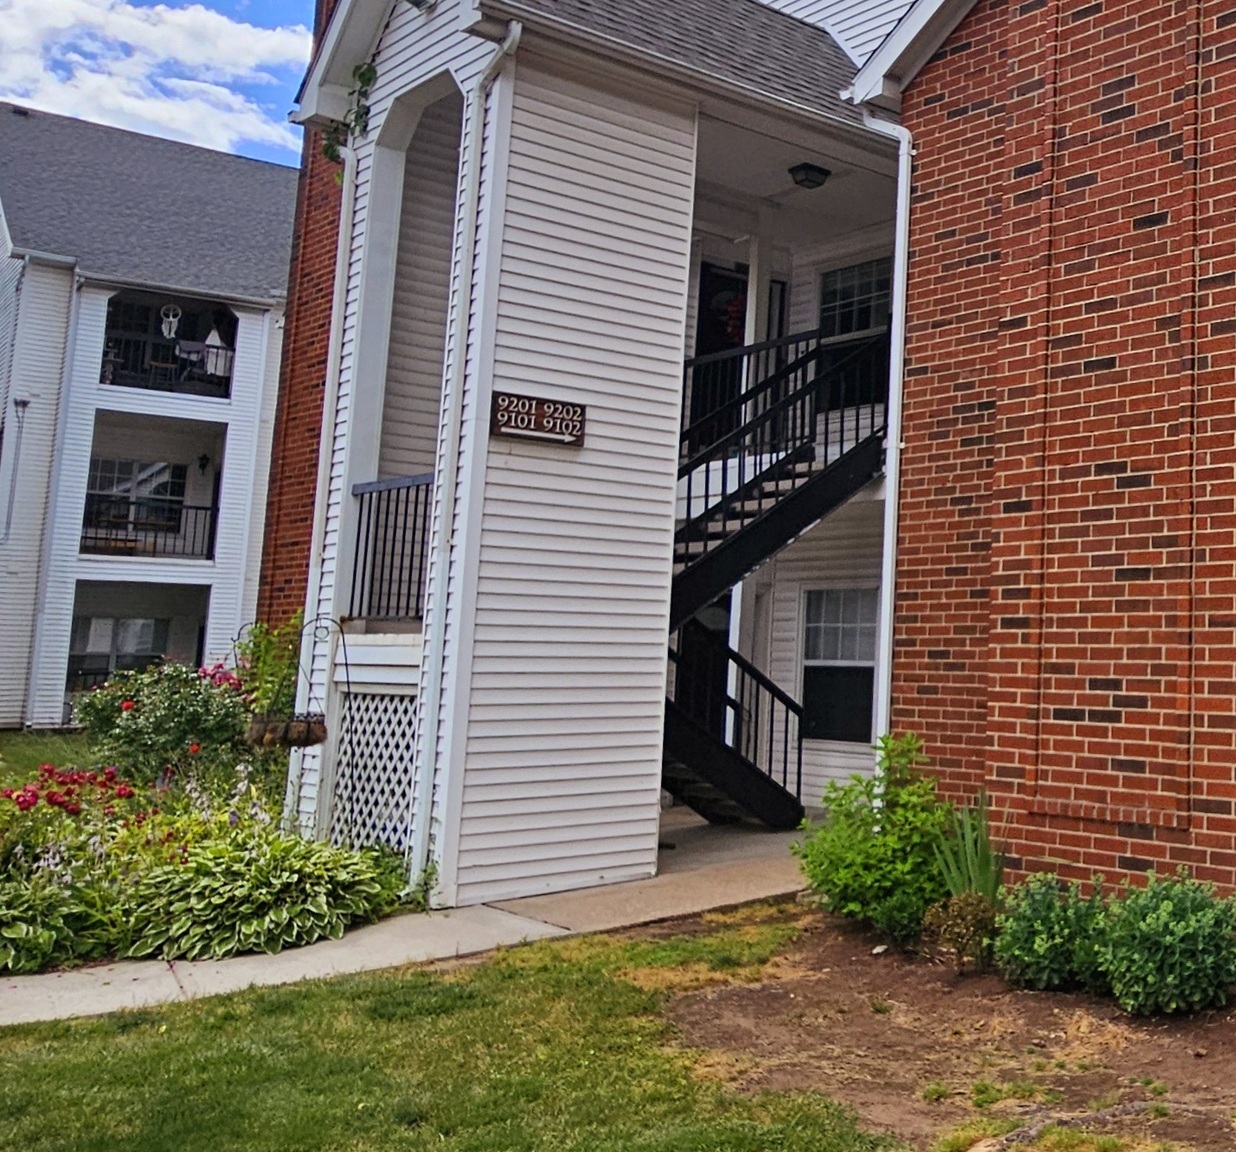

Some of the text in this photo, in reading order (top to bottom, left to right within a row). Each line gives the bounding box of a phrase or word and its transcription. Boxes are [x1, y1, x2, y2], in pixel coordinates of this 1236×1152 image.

[498, 395, 582, 421] 9201 9202
[497, 411, 581, 436] 9101 9102
